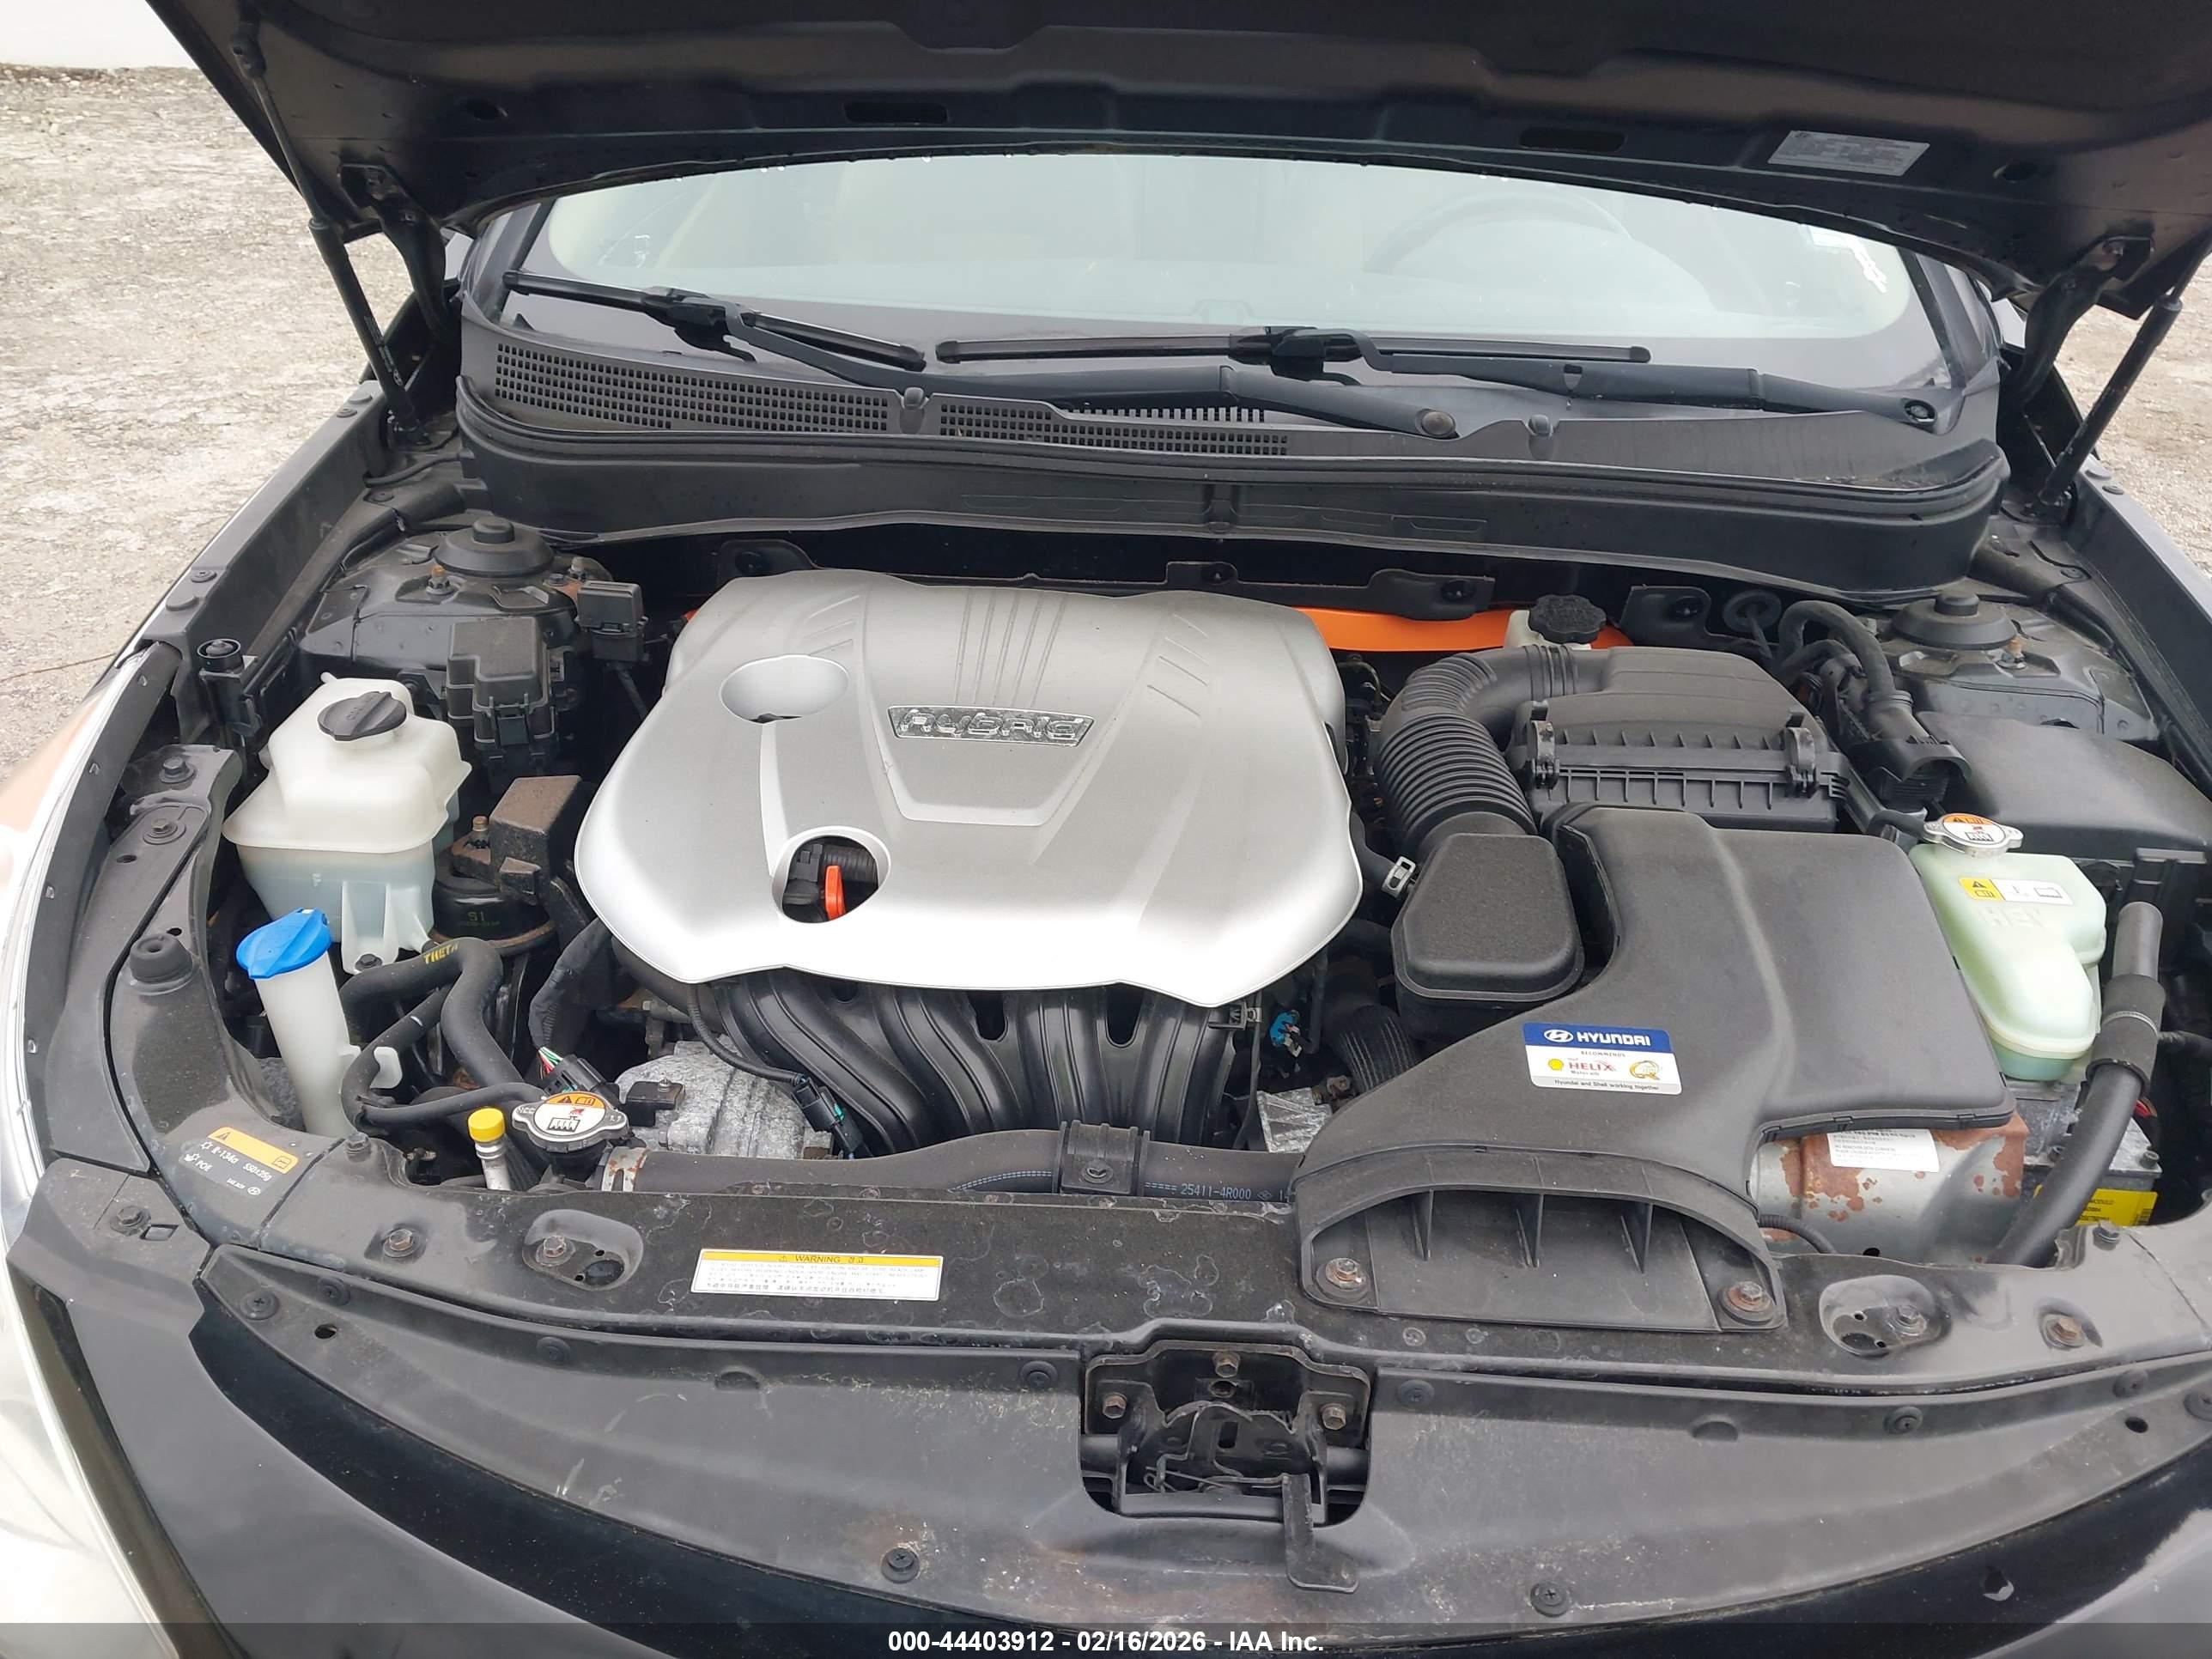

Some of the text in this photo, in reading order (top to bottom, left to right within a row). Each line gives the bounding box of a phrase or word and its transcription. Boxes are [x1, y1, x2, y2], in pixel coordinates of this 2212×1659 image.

[1576, 1030, 1651, 1047] HYUNDAI
[1568, 1060, 1616, 1073] HELIX
[210, 1145, 240, 1164] R-134a
[194, 1158, 213, 1173] POE
[1180, 1182, 1252, 1200] 25411-4R000
[795, 1255, 842, 1264] WARNING
